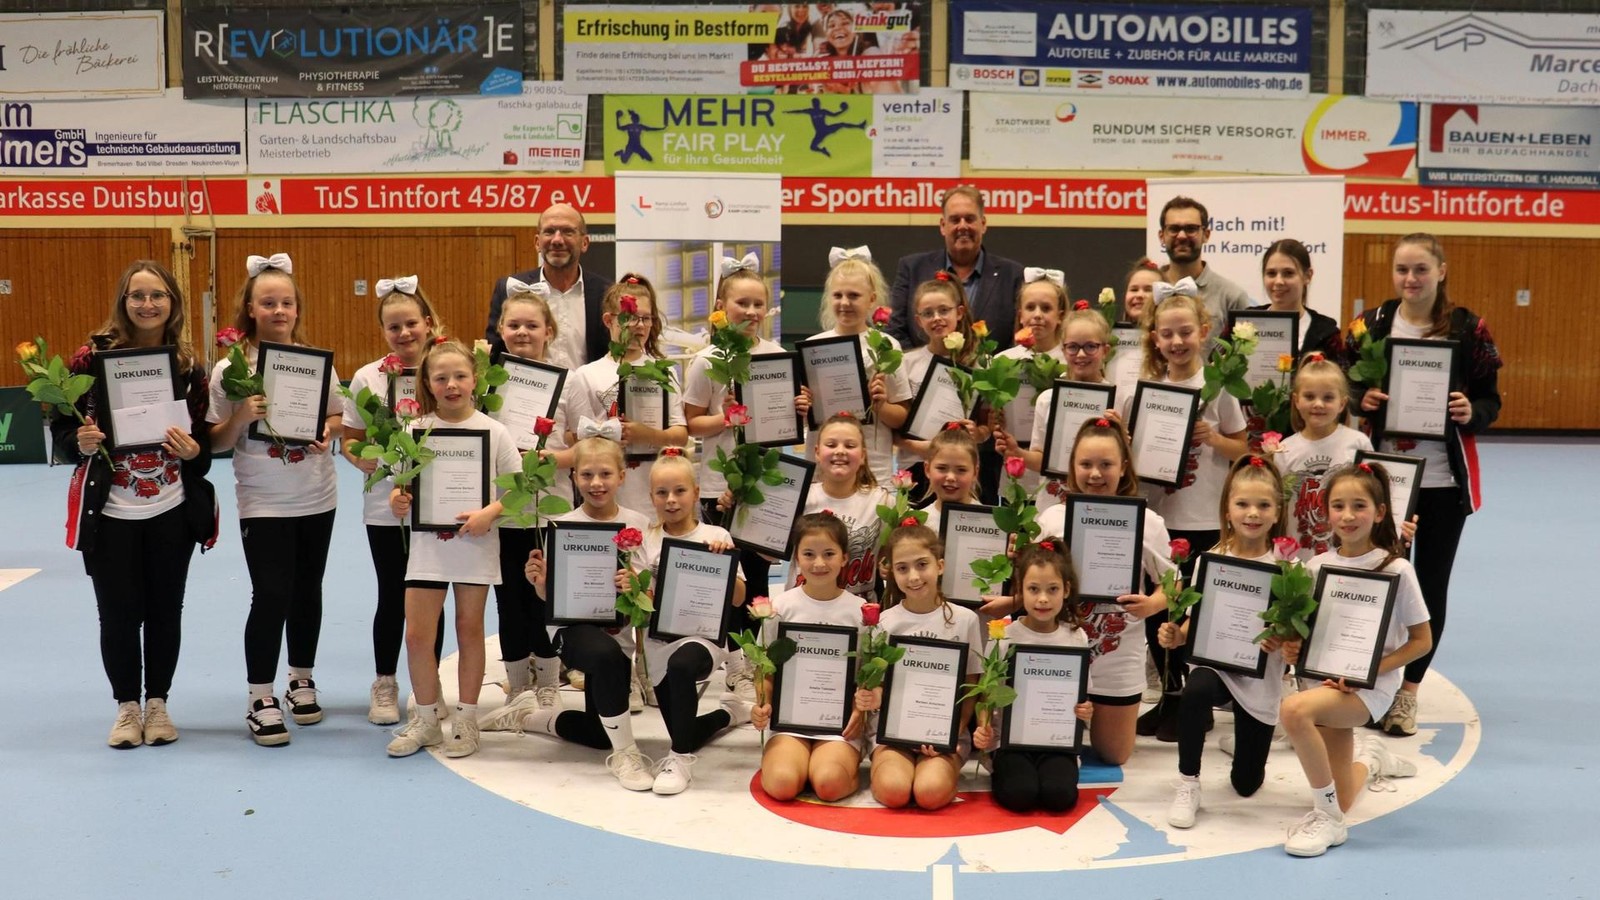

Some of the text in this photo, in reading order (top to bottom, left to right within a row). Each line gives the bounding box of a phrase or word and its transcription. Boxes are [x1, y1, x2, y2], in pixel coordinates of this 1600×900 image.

[854, 12, 910, 30] trinkgut
[577, 19, 769, 41] Erfrischung in Bestform
[1048, 13, 1299, 46] AUTOMOBILES
[19, 44, 49, 64] Die
[52, 38, 111, 66] fröhliche
[576, 51, 598, 60] Finde
[599, 51, 621, 60] deine
[621, 51, 667, 61] Erfrischung
[669, 52, 681, 60] bei
[698, 52, 708, 60] im
[1048, 47, 1298, 64] AUTOTEILE + ZUBEHÖR FÜR ALLE MARKEN!
[76, 54, 139, 75] Bäckerei
[751, 58, 904, 73] DU BESTELLST, WIR LIEFERN!
[197, 76, 279, 84] LEISTUNGSZENTRUM
[299, 71, 380, 81] PHYSIOTHERAPIE
[973, 68, 1015, 80] BOSCH
[1108, 75, 1150, 86] SONAX
[1156, 75, 1303, 91] www.automobiles-ohg.de
[1558, 79, 1600, 93] Dach
[213, 83, 261, 91] NIEDERRHEIN
[316, 83, 365, 91] & FITNESS
[498, 100, 583, 110] flaschka-galabau.de
[258, 100, 396, 125] FLASCHKA
[663, 98, 775, 127] MEHR
[996, 118, 1051, 126] STADTWERKE
[54, 129, 86, 141] GmbH
[95, 131, 158, 143] Ingenieure für
[1092, 124, 1297, 139] RUNDUM SICHER VERSORGT.
[1321, 130, 1371, 142] IMMER.
[259, 133, 397, 145] Garten- & Landschaftsbau
[663, 133, 785, 152] FAIR PLAY
[1449, 130, 1591, 146] BAUEN+LEBEN
[96, 143, 237, 155] technische Gebäudeausrüstung
[259, 149, 331, 159] Meisterbetrieb
[528, 147, 581, 158] METTEN
[1477, 147, 1590, 158] BAUFACHHANDEL
[663, 153, 784, 165] für Ihre Gesundheit
[1428, 171, 1448, 181] WIR
[1450, 171, 1523, 183] UNTERSTÜTZEN
[1525, 174, 1539, 183] DIE
[93, 186, 204, 213] Duisburg
[314, 183, 595, 209] TuS Lintfort 45/87 e.V.
[811, 183, 943, 212] Sporthalle
[957, 184, 1146, 214] amp-Lintfort
[1251, 216, 1286, 232] mit!
[1203, 242, 1216, 254] in
[1254, 330, 1285, 338] KUNDE
[810, 354, 850, 366] URKUNDE
[1398, 359, 1444, 369] URKUNDE
[114, 368, 163, 380] URKUNDE
[272, 363, 317, 376] URKUNDE
[507, 375, 549, 390] URKUNDE
[749, 371, 788, 382] URKUNDE
[629, 386, 660, 394] URKUNDE
[1063, 401, 1101, 411] URKUNDE
[1145, 402, 1184, 415] URKUNDE
[432, 450, 475, 458] RKUNDE
[1080, 516, 1129, 528] URKUNDE
[955, 524, 1000, 536] URKUNDE
[563, 544, 610, 553] URKUNDE
[675, 561, 722, 575] URKUNDE
[1213, 577, 1262, 595] URKUNDE
[1330, 589, 1378, 604] URKUNDE
[903, 659, 951, 671] URKUNDE
[1023, 667, 1073, 678] URKUNDE
